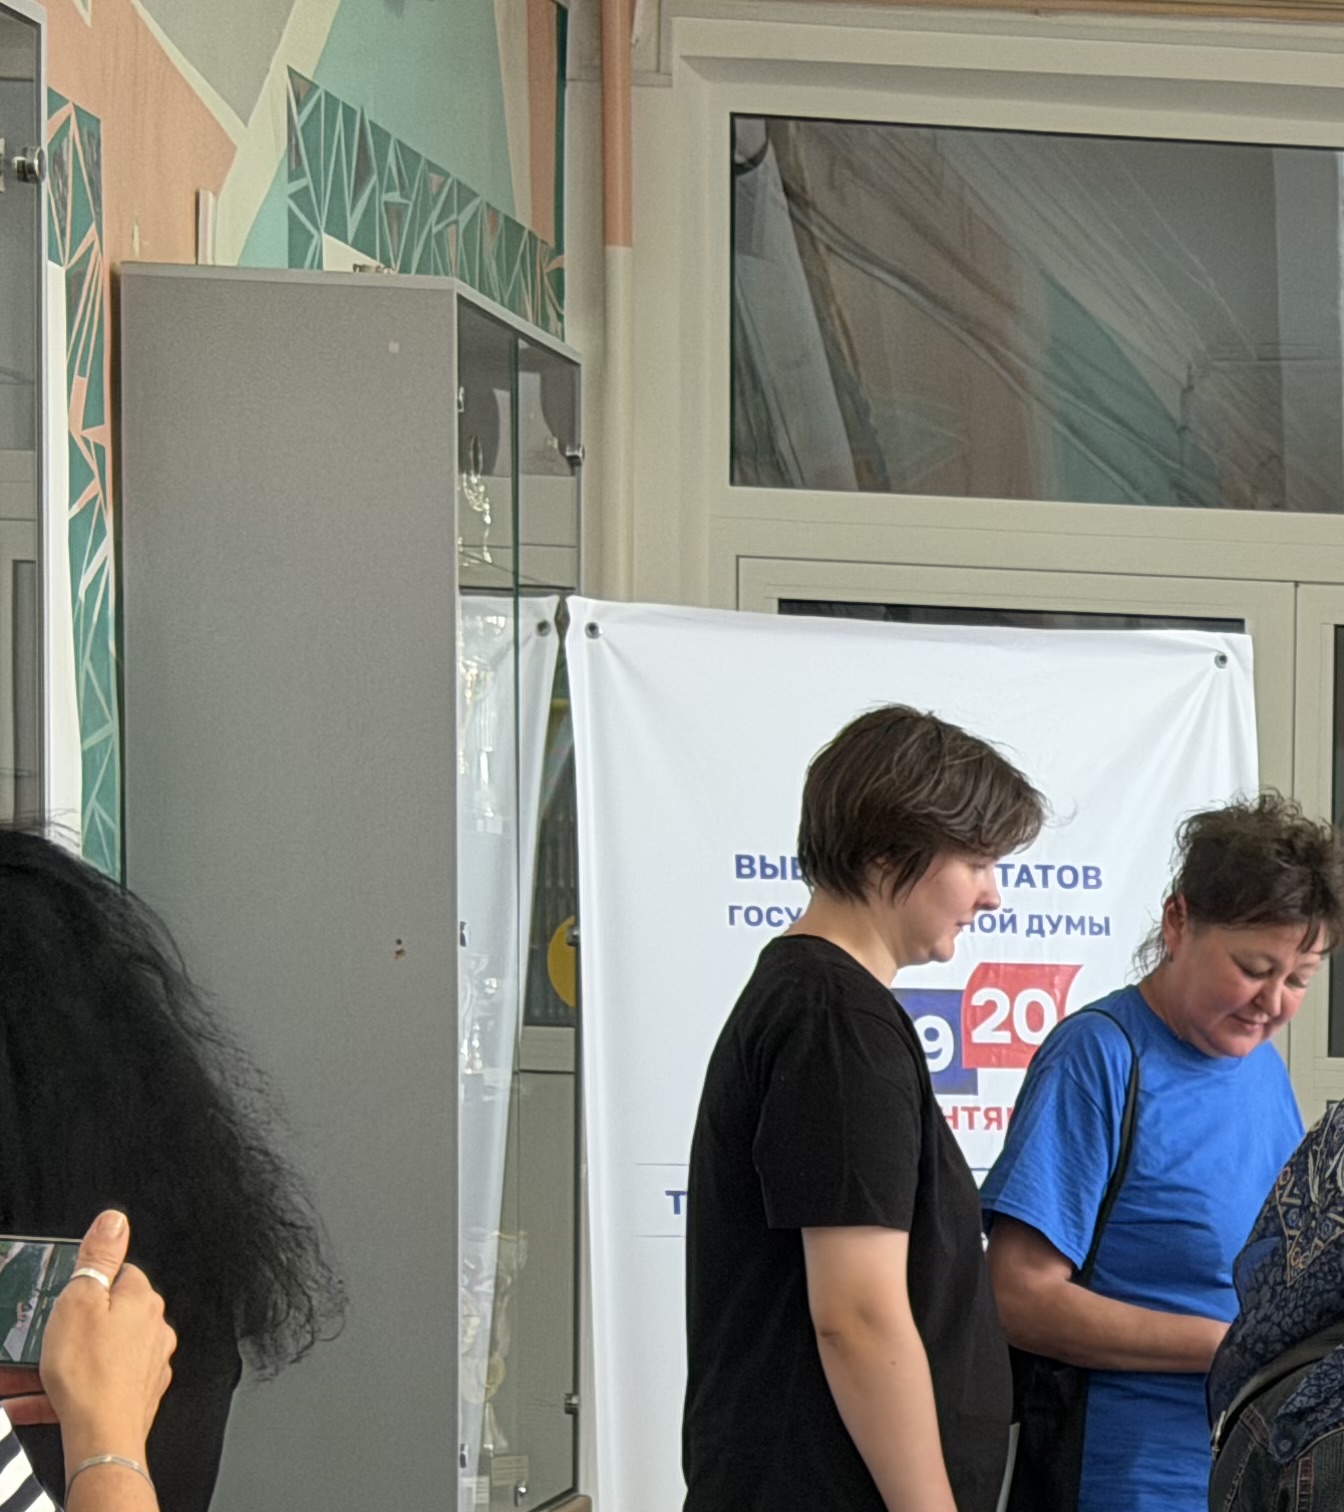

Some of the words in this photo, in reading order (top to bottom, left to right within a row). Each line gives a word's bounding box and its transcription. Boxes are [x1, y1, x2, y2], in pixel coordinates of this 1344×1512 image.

[994, 863, 1103, 890] ТАТОВ
[728, 905, 802, 928] ГОСУ
[1025, 914, 1111, 938] ДУМЫ
[970, 987, 1058, 1046] 20
[914, 1015, 955, 1073] 9
